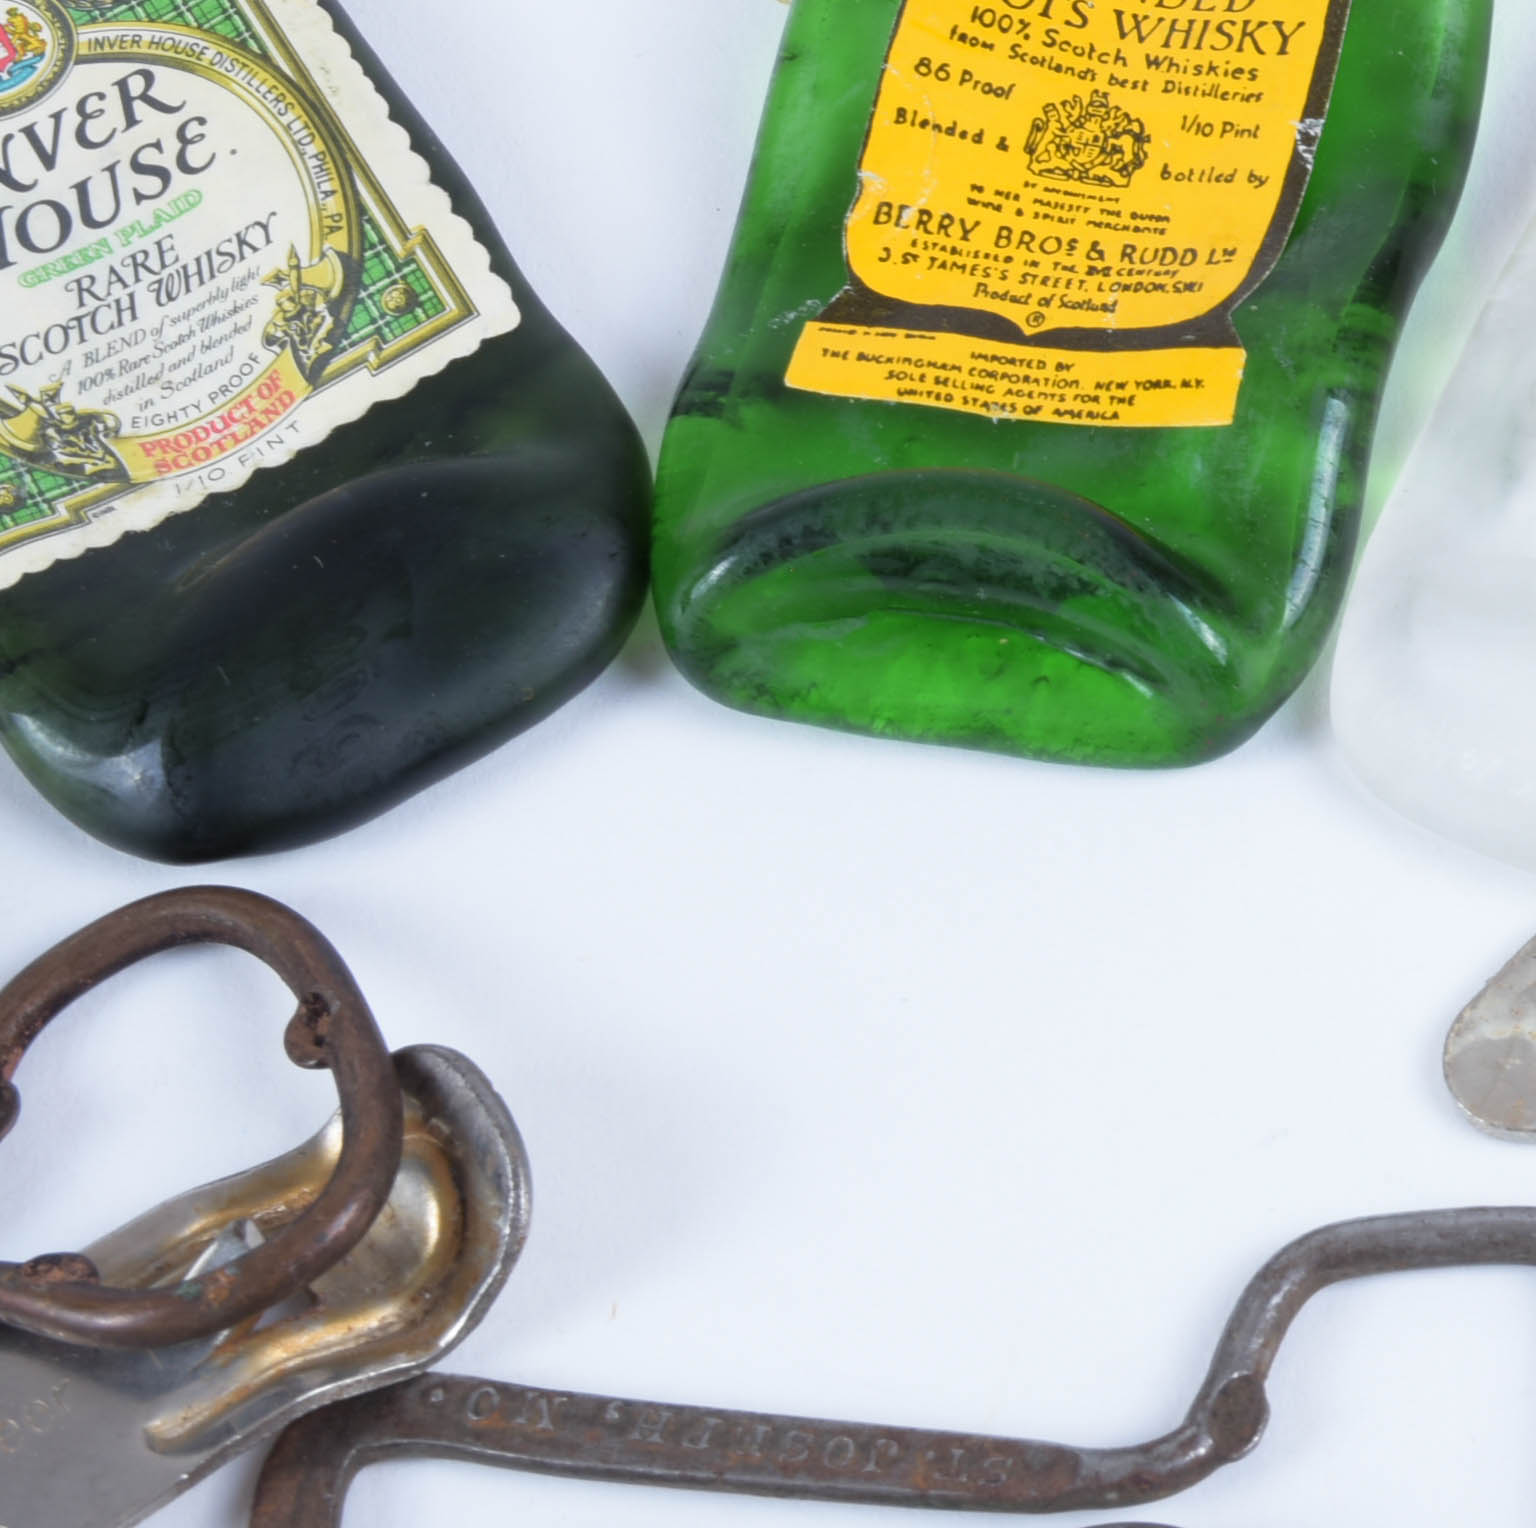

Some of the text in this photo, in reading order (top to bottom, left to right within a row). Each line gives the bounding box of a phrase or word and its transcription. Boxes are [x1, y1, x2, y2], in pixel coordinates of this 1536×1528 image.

[970, 5, 1259, 82] 100% Scotch Whiskies
[1113, 8, 1306, 56] WHISKY
[87, 33, 143, 52] INVER
[147, 36, 210, 62] HOUSE
[208, 50, 296, 117] DISTILLERS
[913, 56, 1017, 101] 86 Proof
[1007, 43, 1098, 83] Scotland's
[1107, 72, 1150, 93] best
[1160, 79, 1265, 104] Distilleries
[893, 106, 985, 145] Blended
[1180, 114, 1261, 140] 1/10 Pint
[1159, 162, 1270, 190] bottled by
[13, 188, 203, 296] GREEN PLAID
[872, 201, 982, 242] BERRY
[1085, 239, 1106, 262] &
[1119, 243, 1199, 267] RUDD
[0, 211, 277, 377] SCOTCH WHISKY
[64, 233, 180, 309] RARE
[973, 281, 1119, 314] Product of Scotland
[82, 328, 147, 369] BLEND
[152, 344, 235, 400] Scotland
[130, 352, 261, 430] EIGHTY PROOF
[134, 364, 289, 462] PRODUCT OF
[152, 389, 296, 477] SCOTLAND
